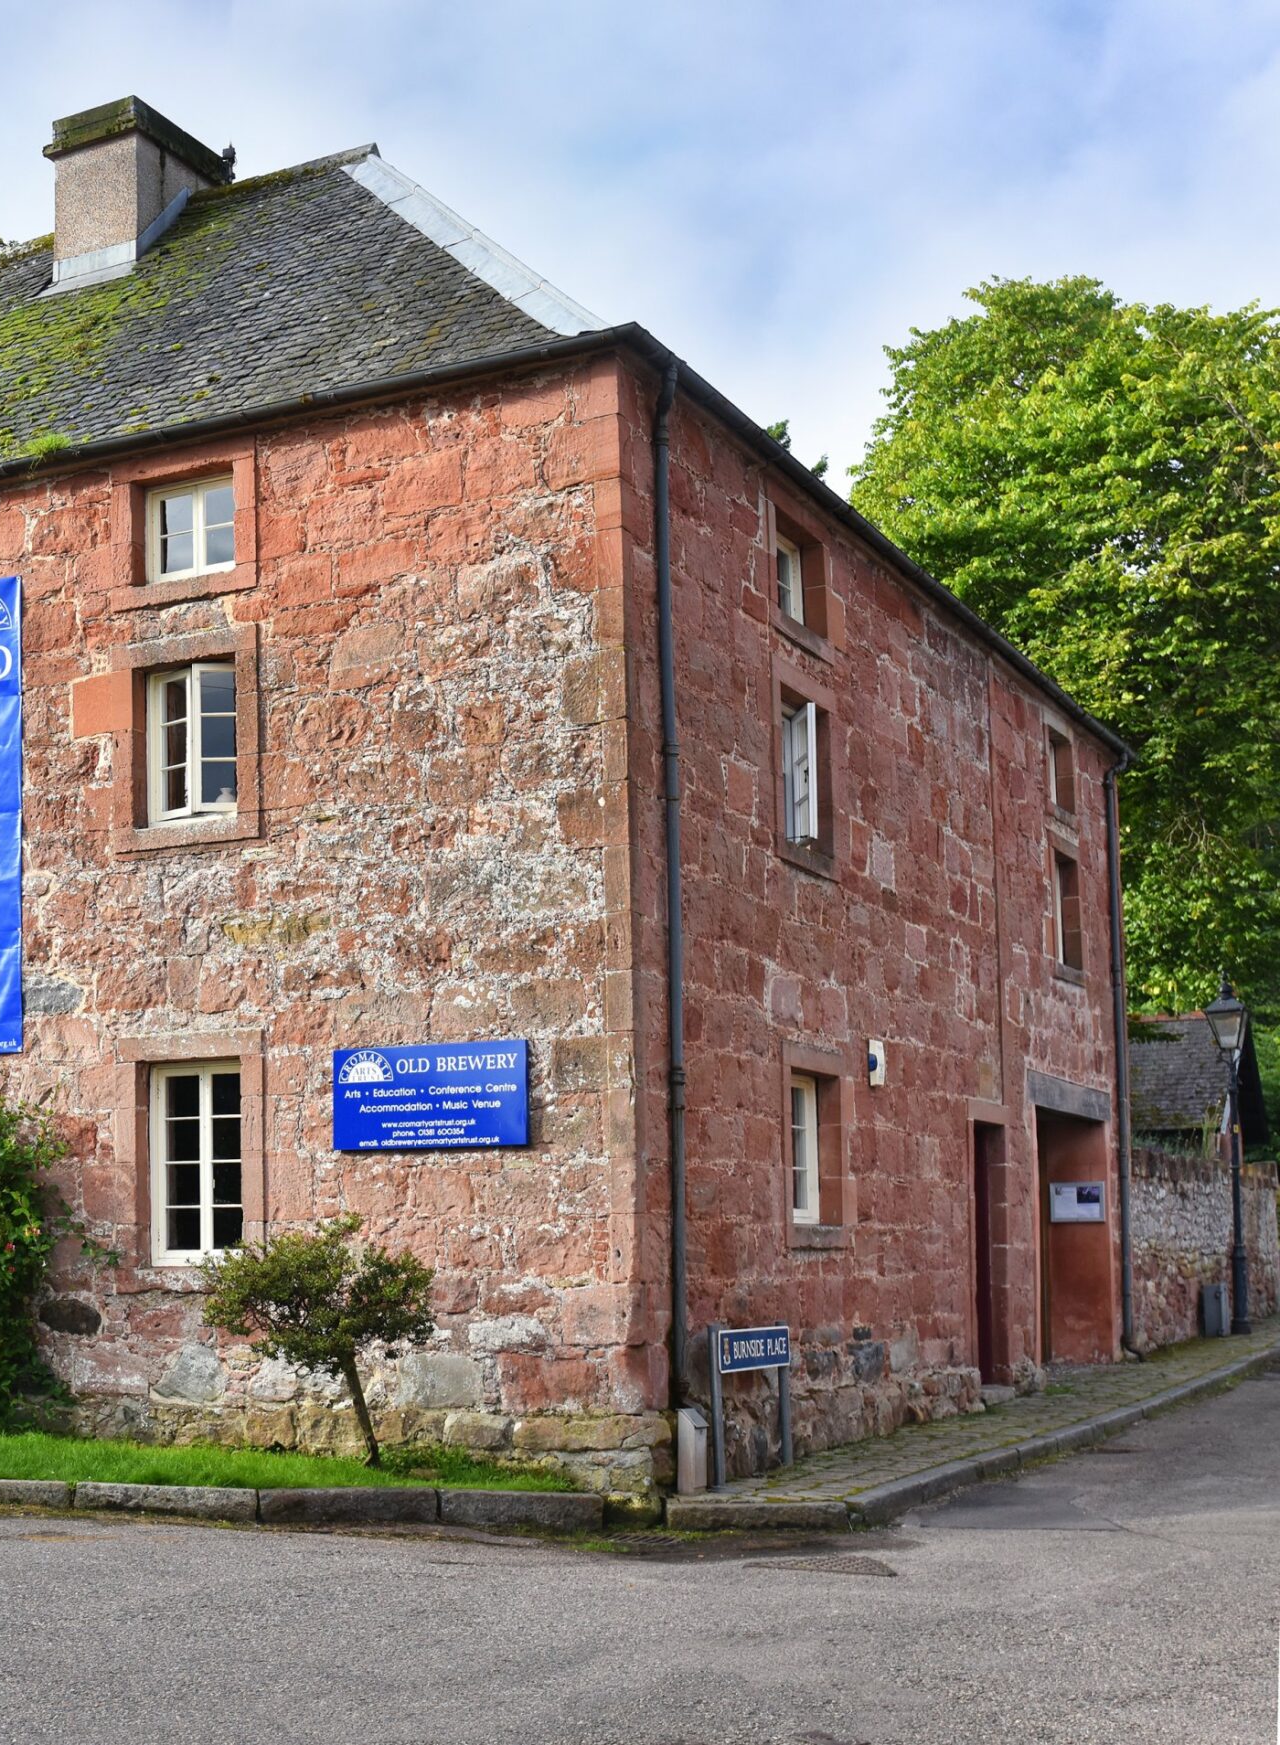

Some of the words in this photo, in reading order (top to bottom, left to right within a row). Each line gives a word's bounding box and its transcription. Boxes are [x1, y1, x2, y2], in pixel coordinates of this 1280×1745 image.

[341, 1052, 392, 1081] CROMARTY
[355, 1067, 377, 1076] ARTS
[396, 1057, 430, 1074] OLD
[436, 1053, 518, 1072] BREWERY
[344, 1089, 361, 1099] Arts
[373, 1087, 416, 1098] Education
[428, 1085, 482, 1096] Conference
[485, 1083, 517, 1093] Centre
[359, 1102, 433, 1114] Accommodation
[442, 1099, 468, 1110] Music
[472, 1099, 501, 1109] Venue
[381, 1118, 476, 1129] www.cromartyartstrust.org.uk
[733, 1339, 765, 1360] BURNSIDE
[767, 1337, 787, 1357] PLACE
